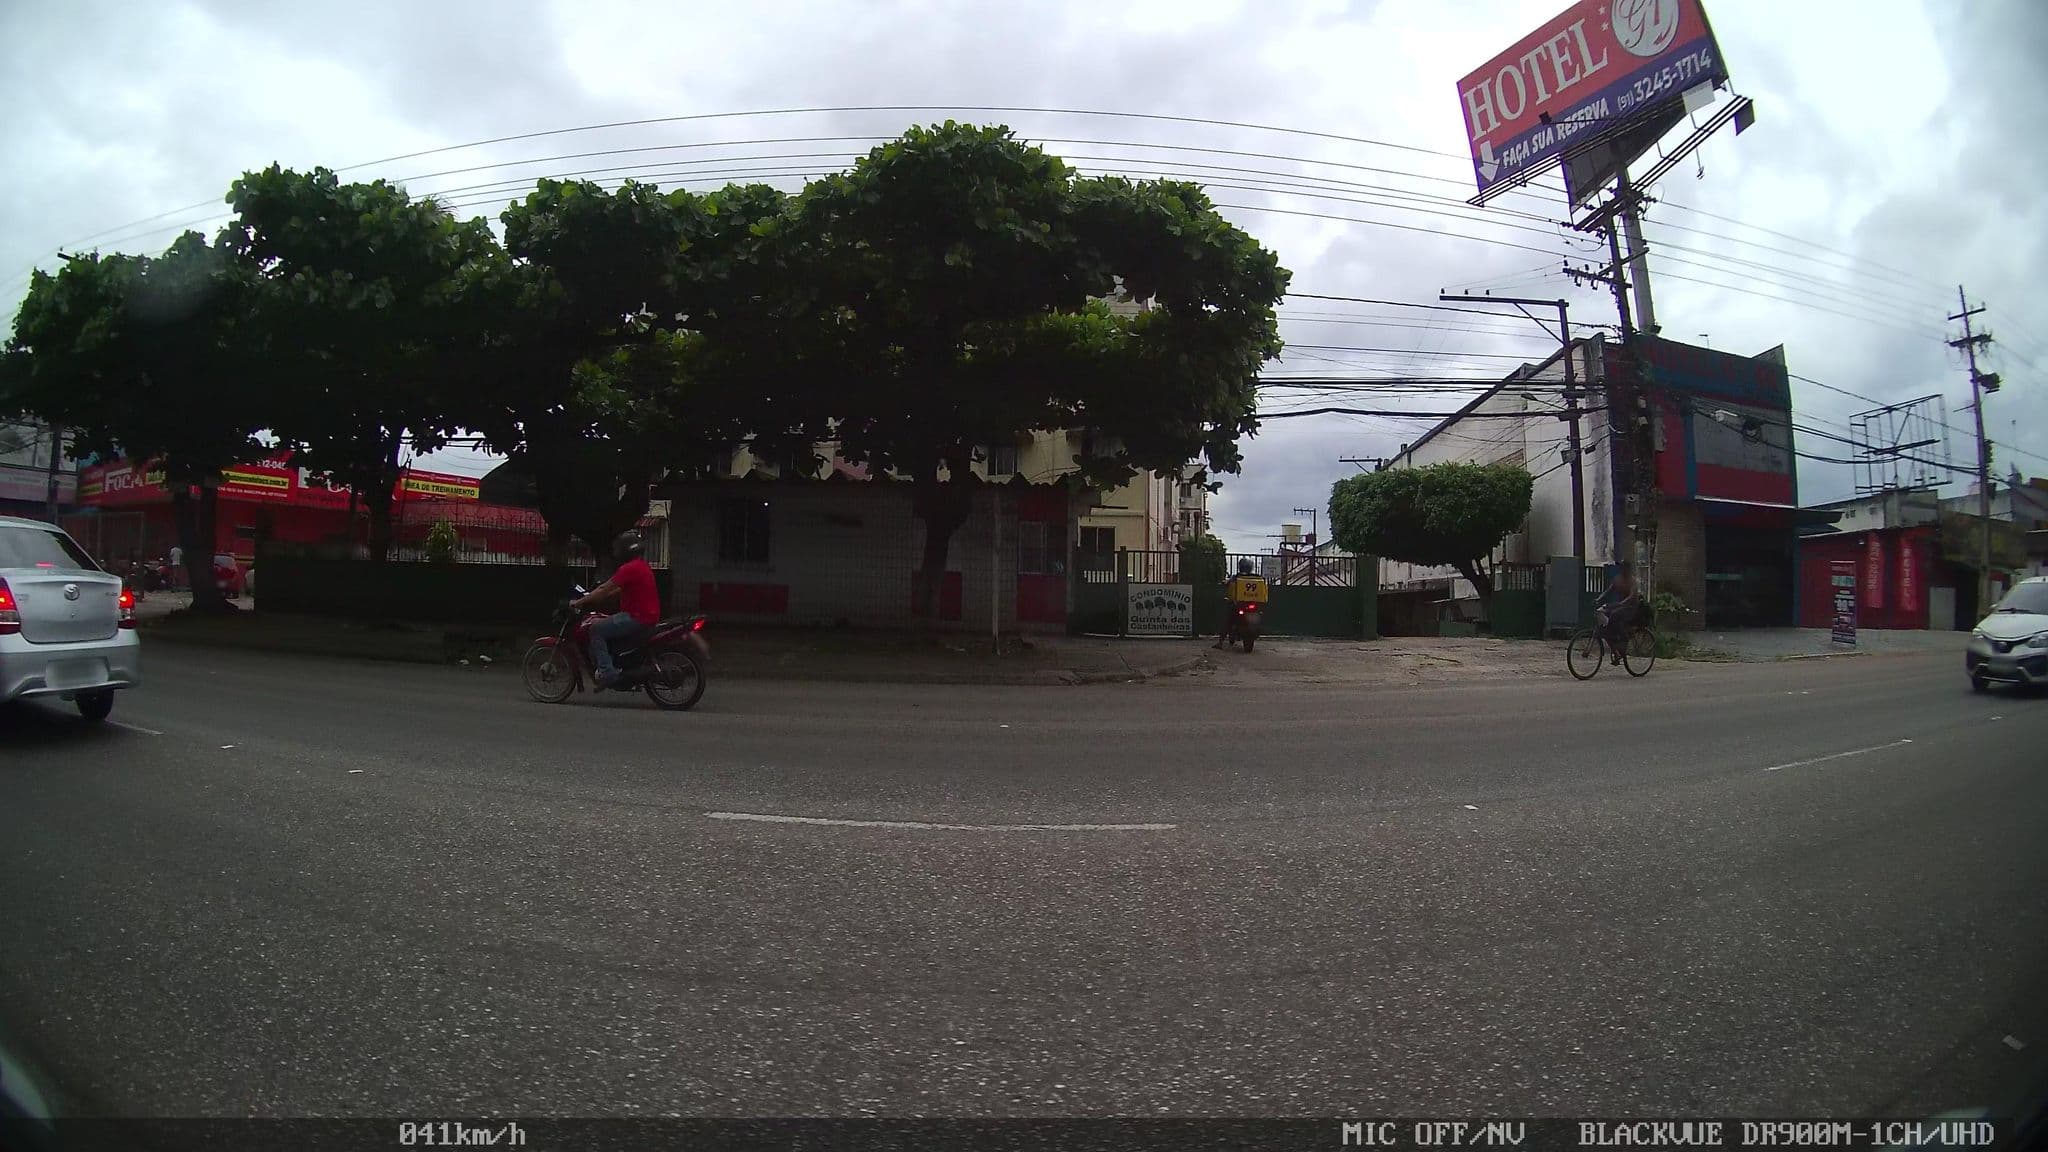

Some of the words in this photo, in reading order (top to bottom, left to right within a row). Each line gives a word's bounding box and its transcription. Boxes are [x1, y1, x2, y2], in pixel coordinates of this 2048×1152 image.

[1463, 18, 1608, 141] HOTEL
[1502, 141, 1530, 168] FAÇA
[1532, 128, 1554, 152] SUA
[1557, 97, 1610, 141] RESERVA
[1617, 91, 1635, 111] (91)
[1634, 48, 1712, 102] 3245-1714
[1245, 582, 1257, 592] 99
[1130, 615, 1167, 623] Quinta
[1171, 615, 1190, 623] das
[1130, 622, 1190, 630] Castanheiras
